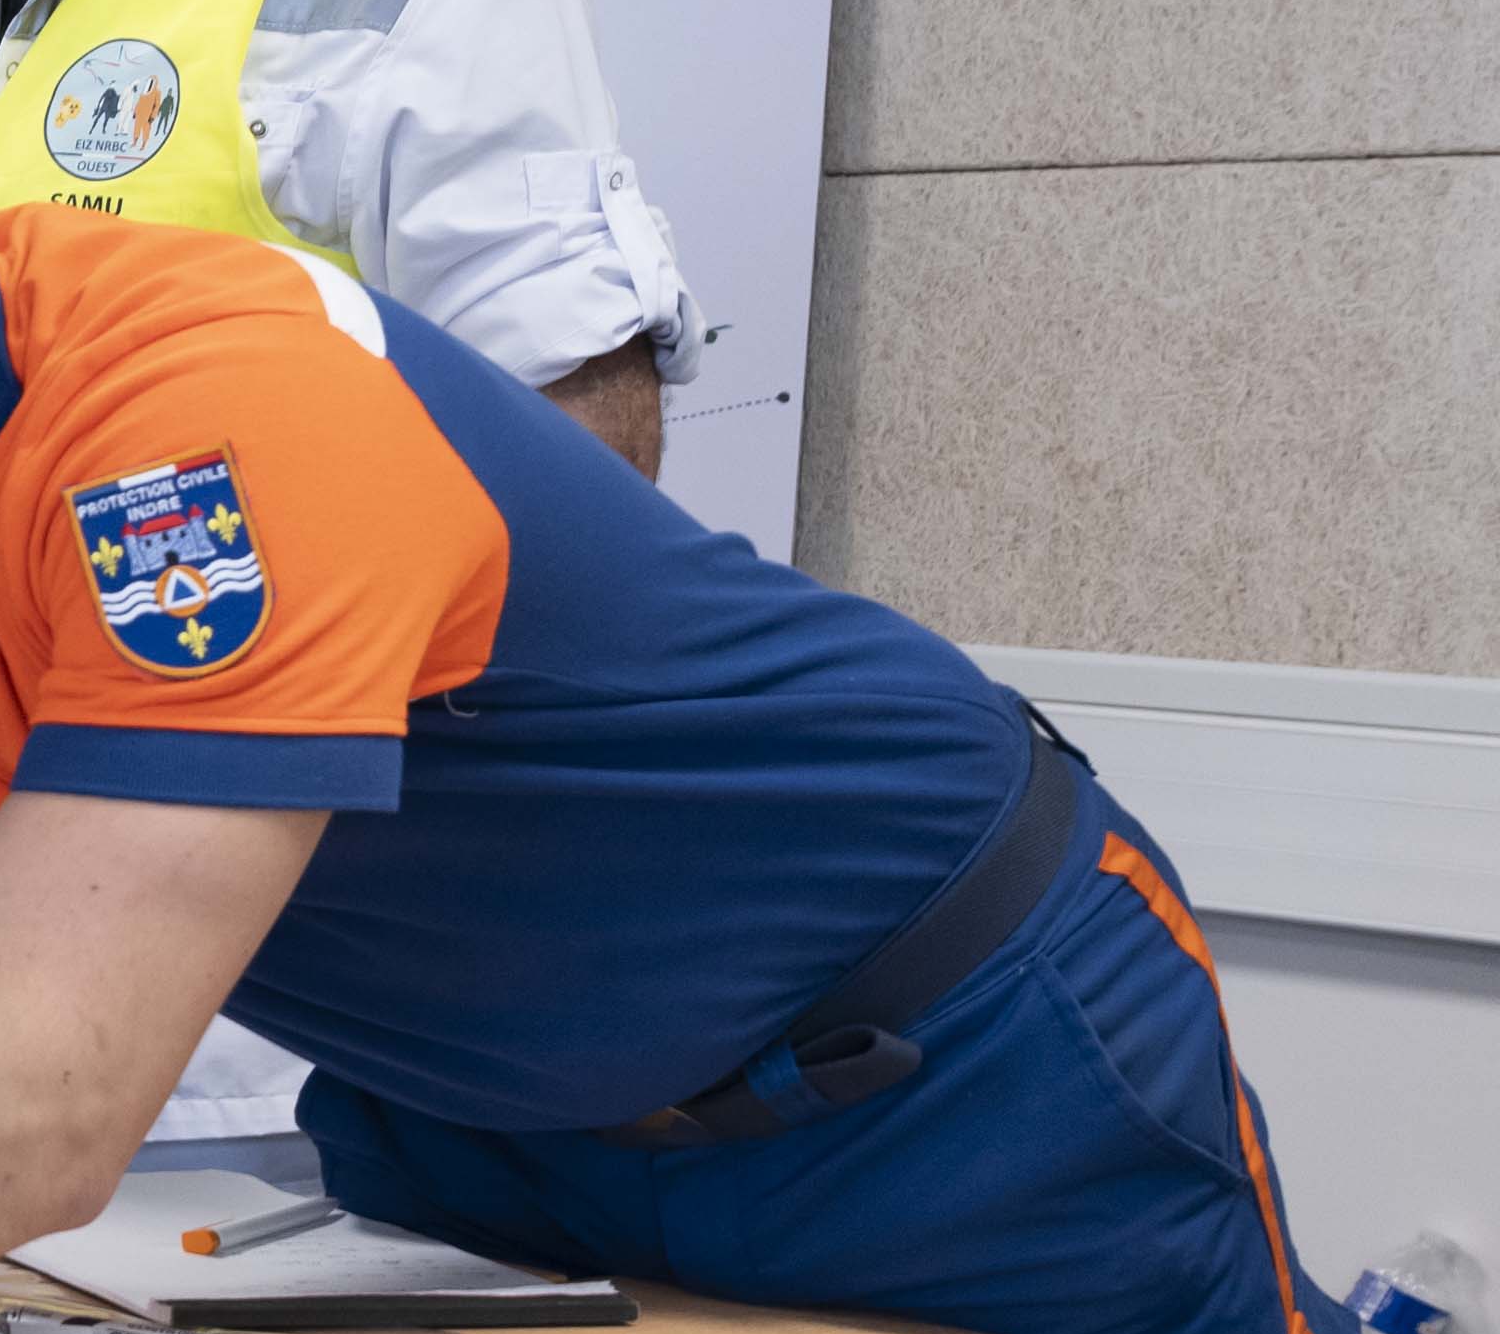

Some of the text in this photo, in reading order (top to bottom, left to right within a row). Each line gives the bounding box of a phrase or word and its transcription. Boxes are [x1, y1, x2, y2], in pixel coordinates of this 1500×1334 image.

[75, 138, 129, 153] EIZ NRBC
[77, 160, 117, 174] OUEST
[76, 464, 230, 519] PROTECTION CIVILE
[127, 495, 183, 522] INDRE
